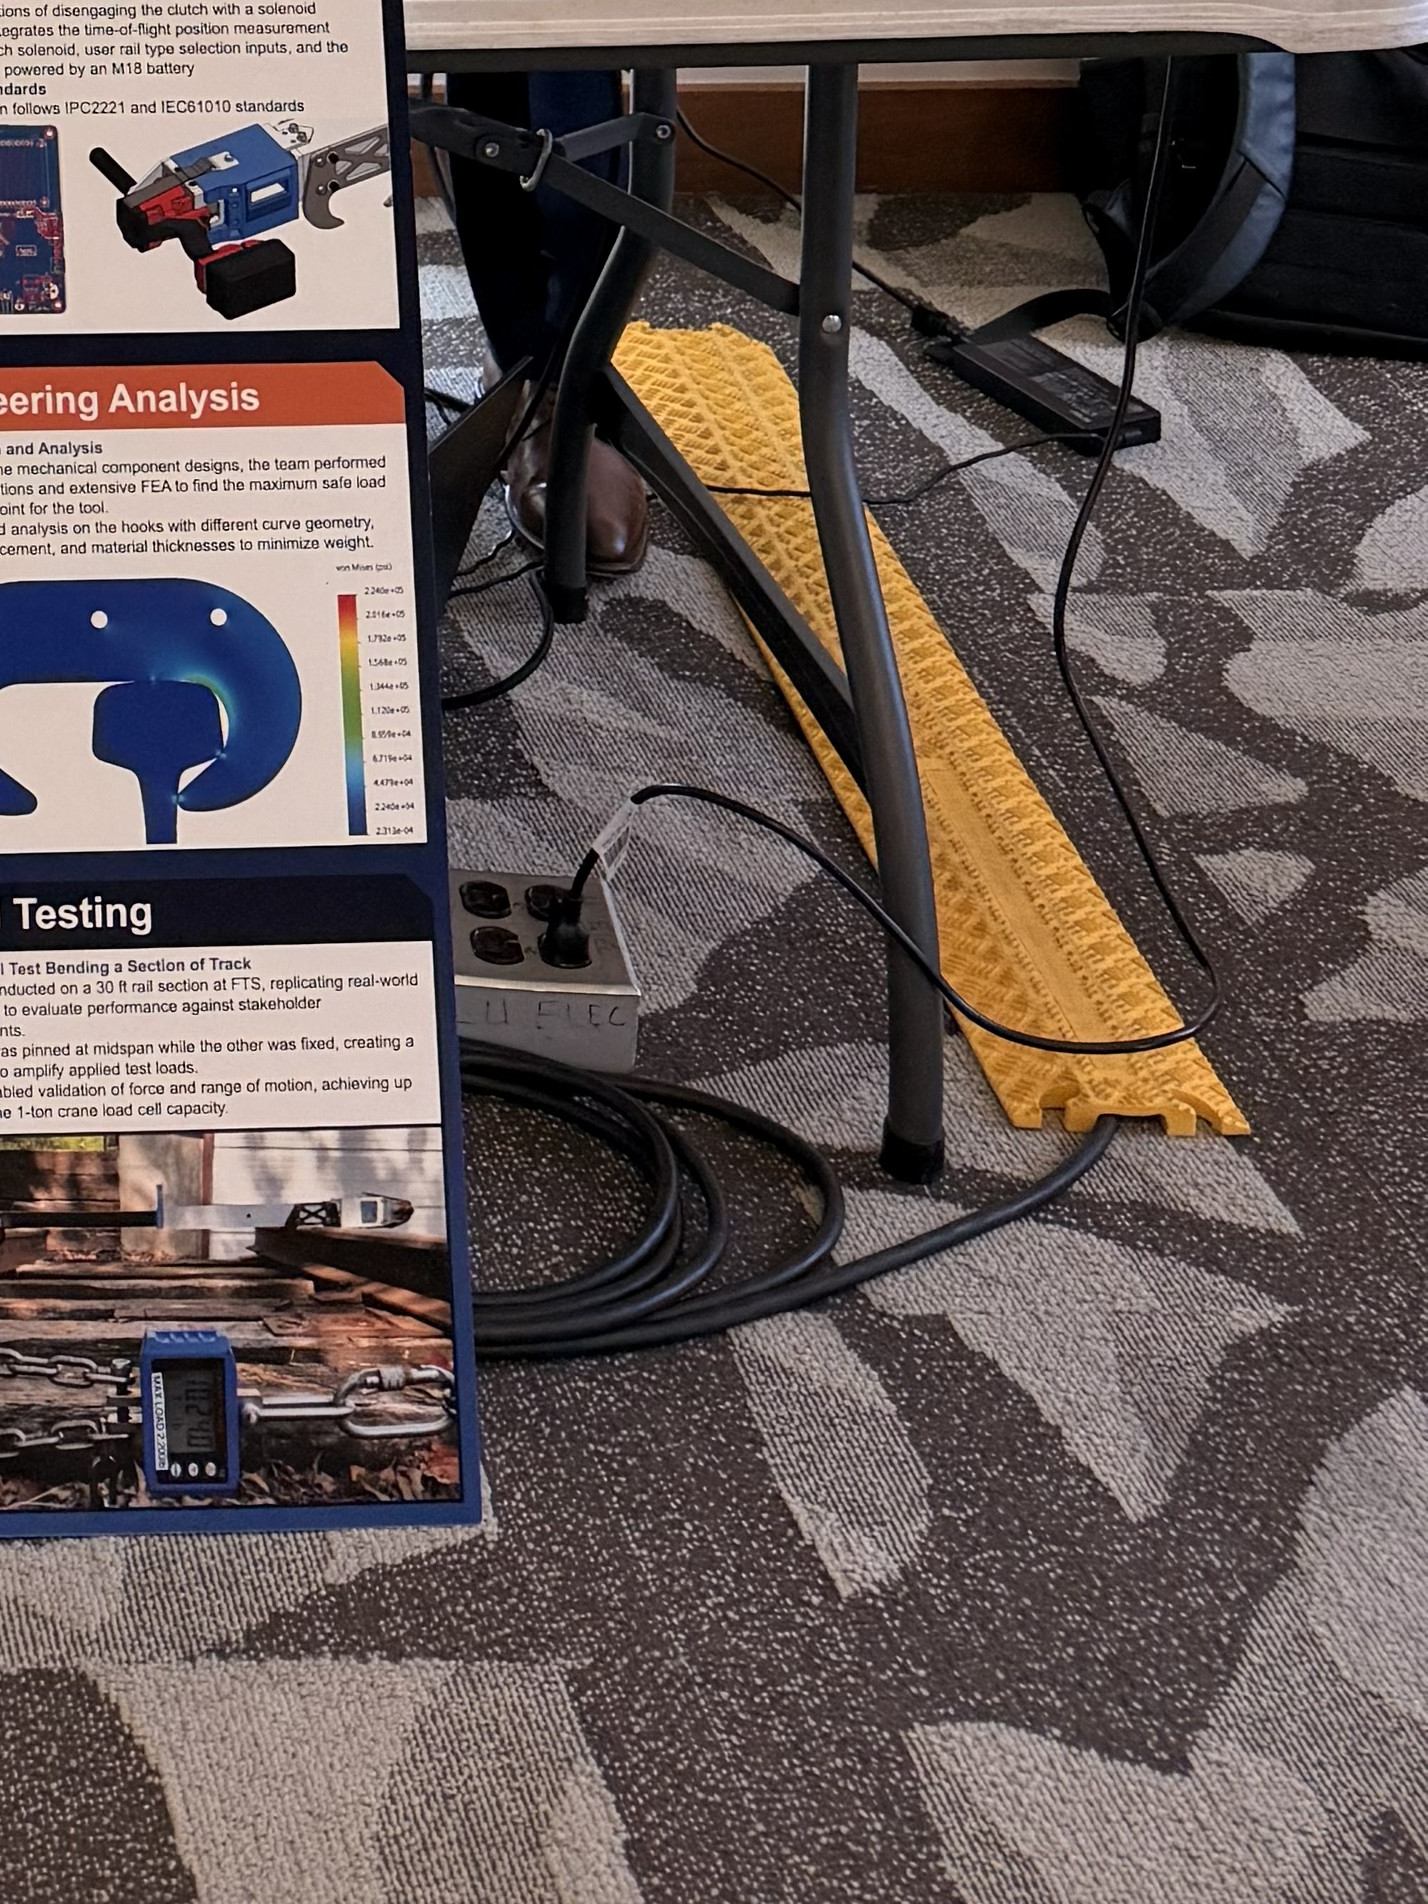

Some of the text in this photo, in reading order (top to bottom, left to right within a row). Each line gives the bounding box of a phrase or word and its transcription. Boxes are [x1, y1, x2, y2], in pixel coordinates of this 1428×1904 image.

[108, 381, 260, 419] Analysis
[6, 442, 34, 455] and
[38, 440, 102, 458] Analysis
[12, 895, 151, 935] Testing
[8, 962, 41, 975] Test
[45, 960, 109, 977] Bending
[114, 962, 122, 973] a
[127, 958, 185, 972] Section
[189, 957, 205, 971] of
[208, 957, 251, 971] Track
[456, 999, 508, 1024] U
